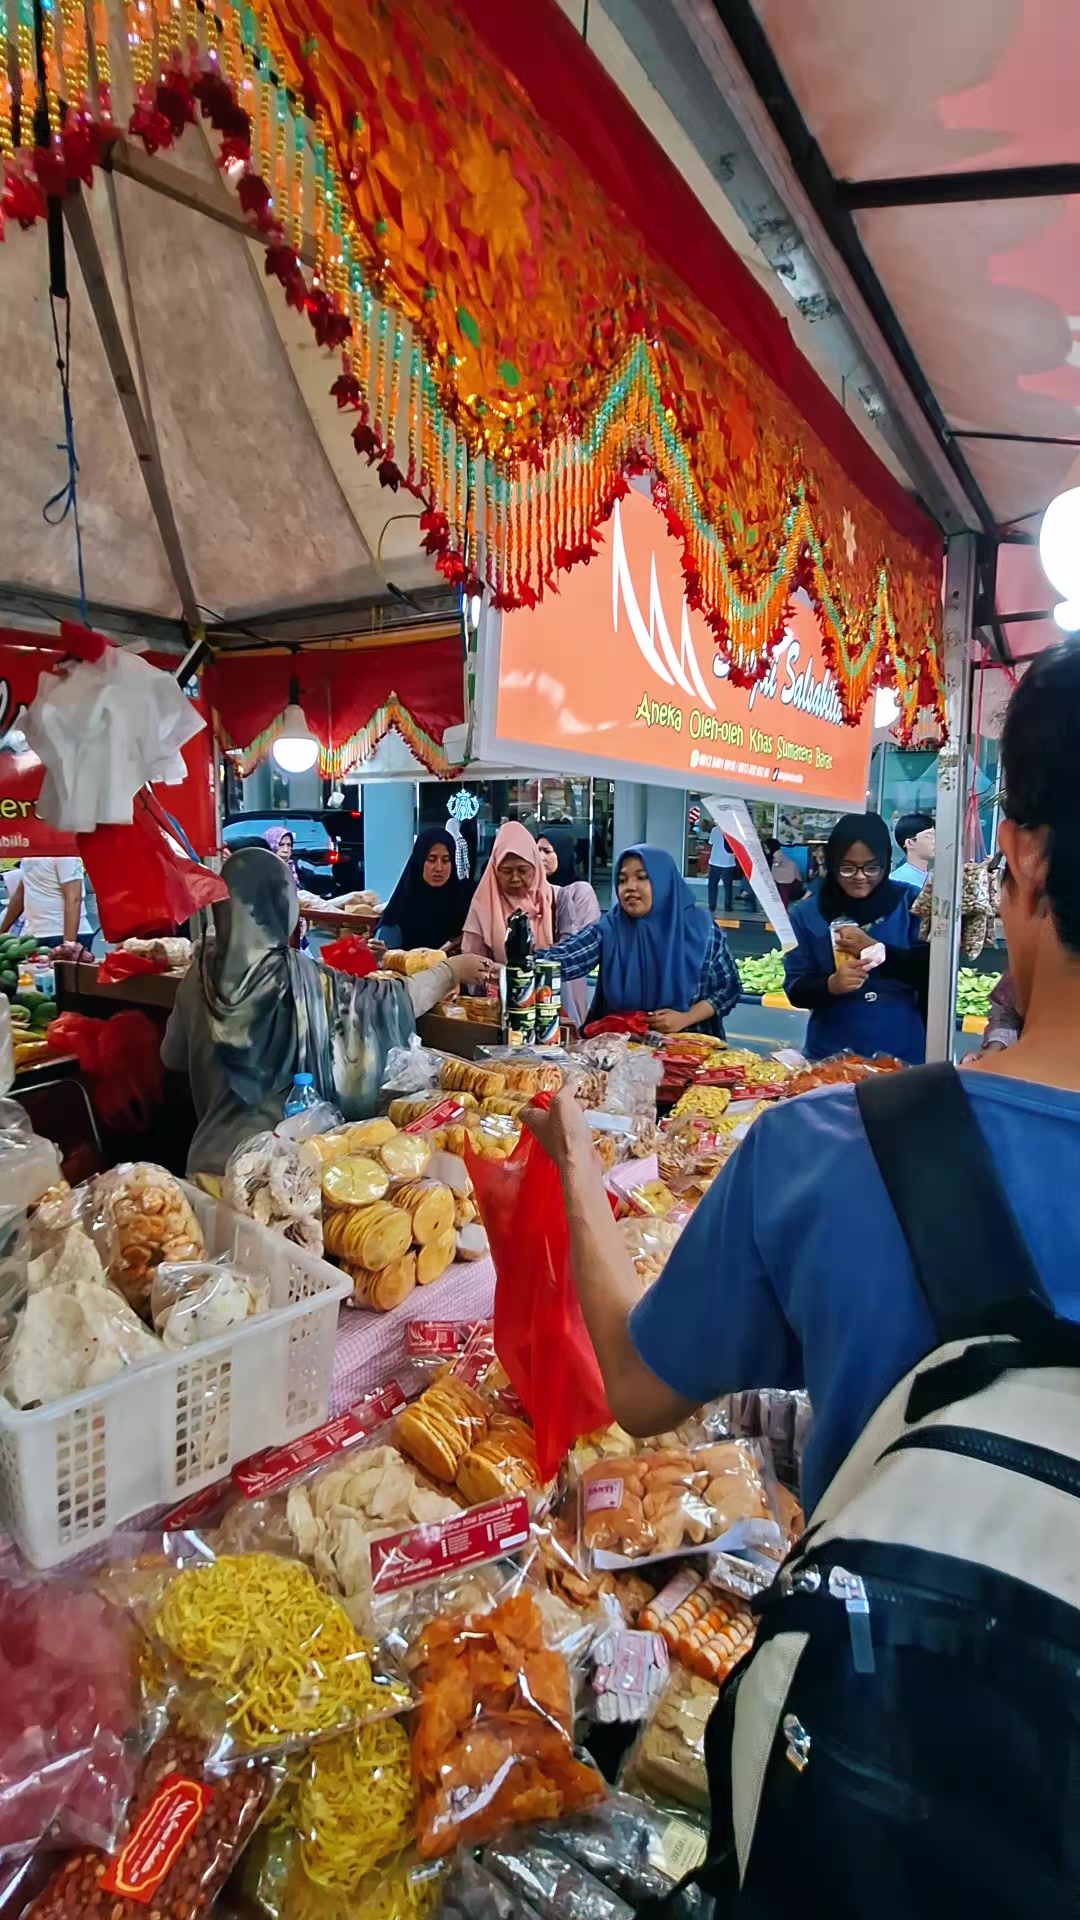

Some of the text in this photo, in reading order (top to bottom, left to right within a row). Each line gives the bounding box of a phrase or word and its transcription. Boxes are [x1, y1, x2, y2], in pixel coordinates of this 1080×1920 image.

[635, 692, 833, 770] Aneka Oleh-oleh Khas Sumatera Barat
